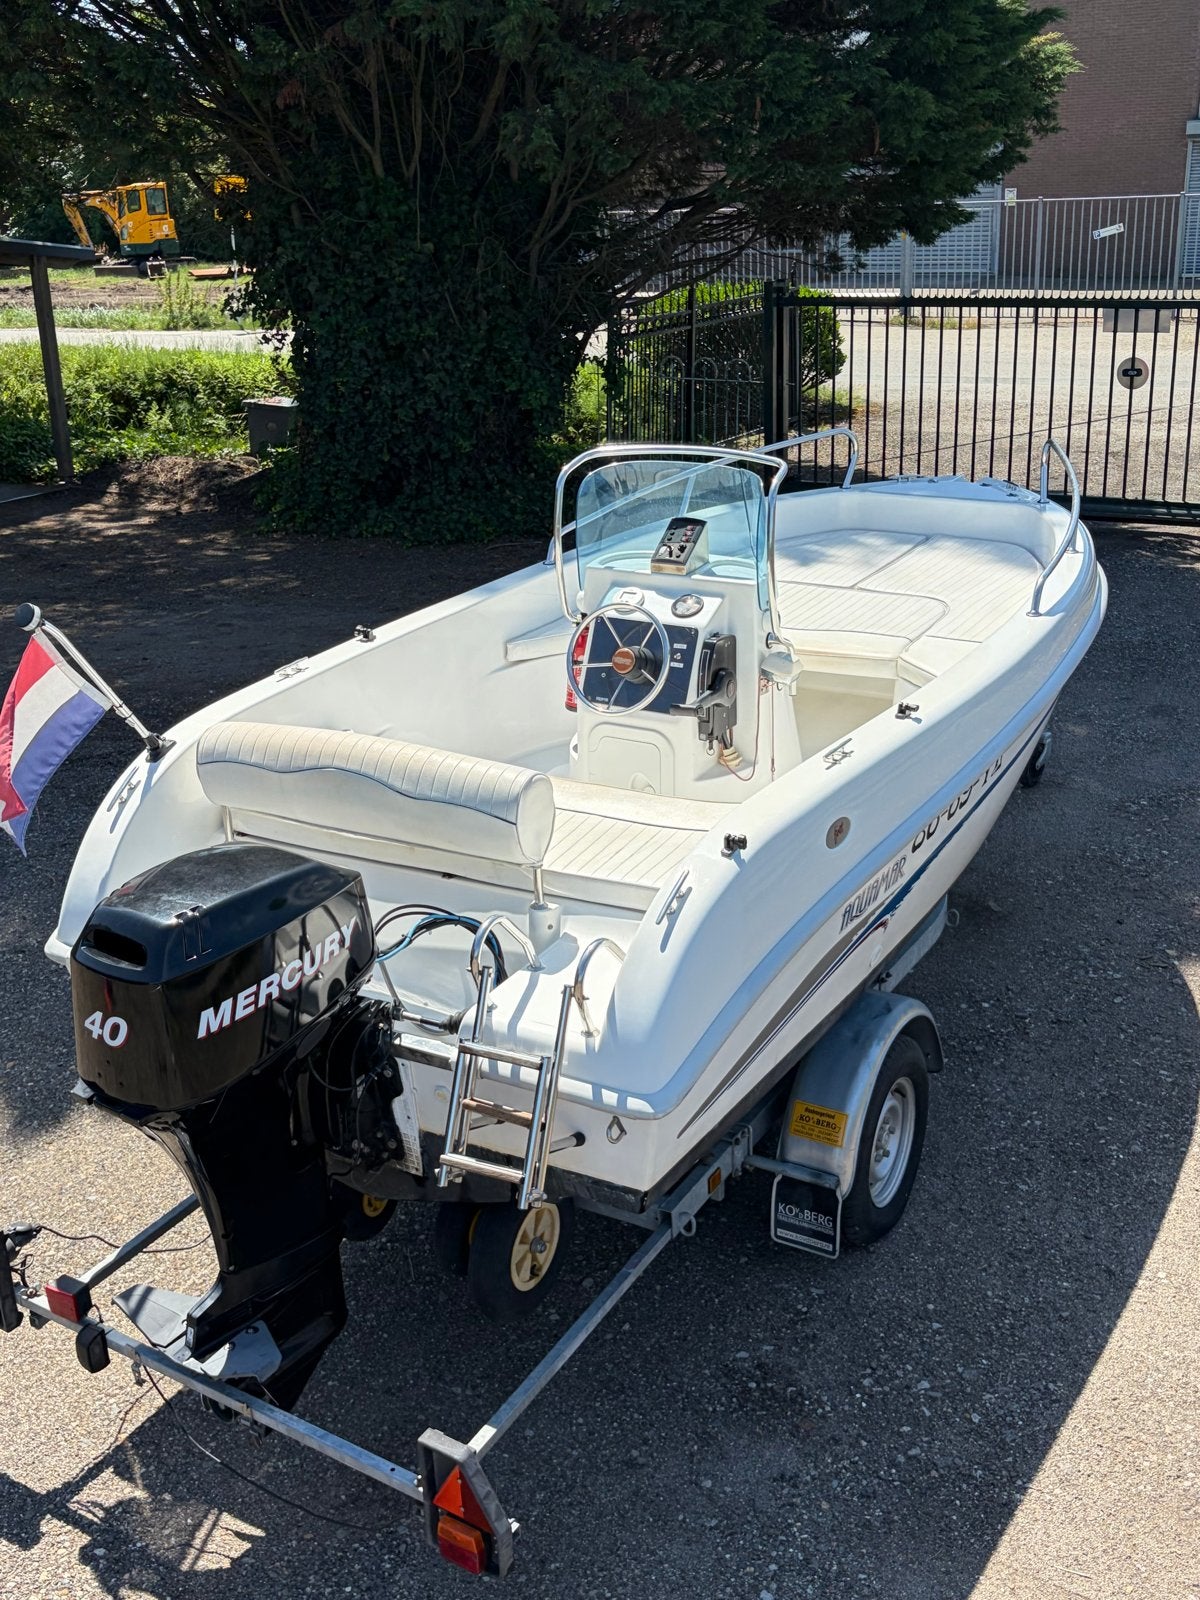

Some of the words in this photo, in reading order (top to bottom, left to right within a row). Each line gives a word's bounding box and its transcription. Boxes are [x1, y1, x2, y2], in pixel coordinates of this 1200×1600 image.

[839, 854, 908, 934] AQUAMAR
[197, 918, 357, 1040] MERCURY
[84, 1011, 129, 1048] 40
